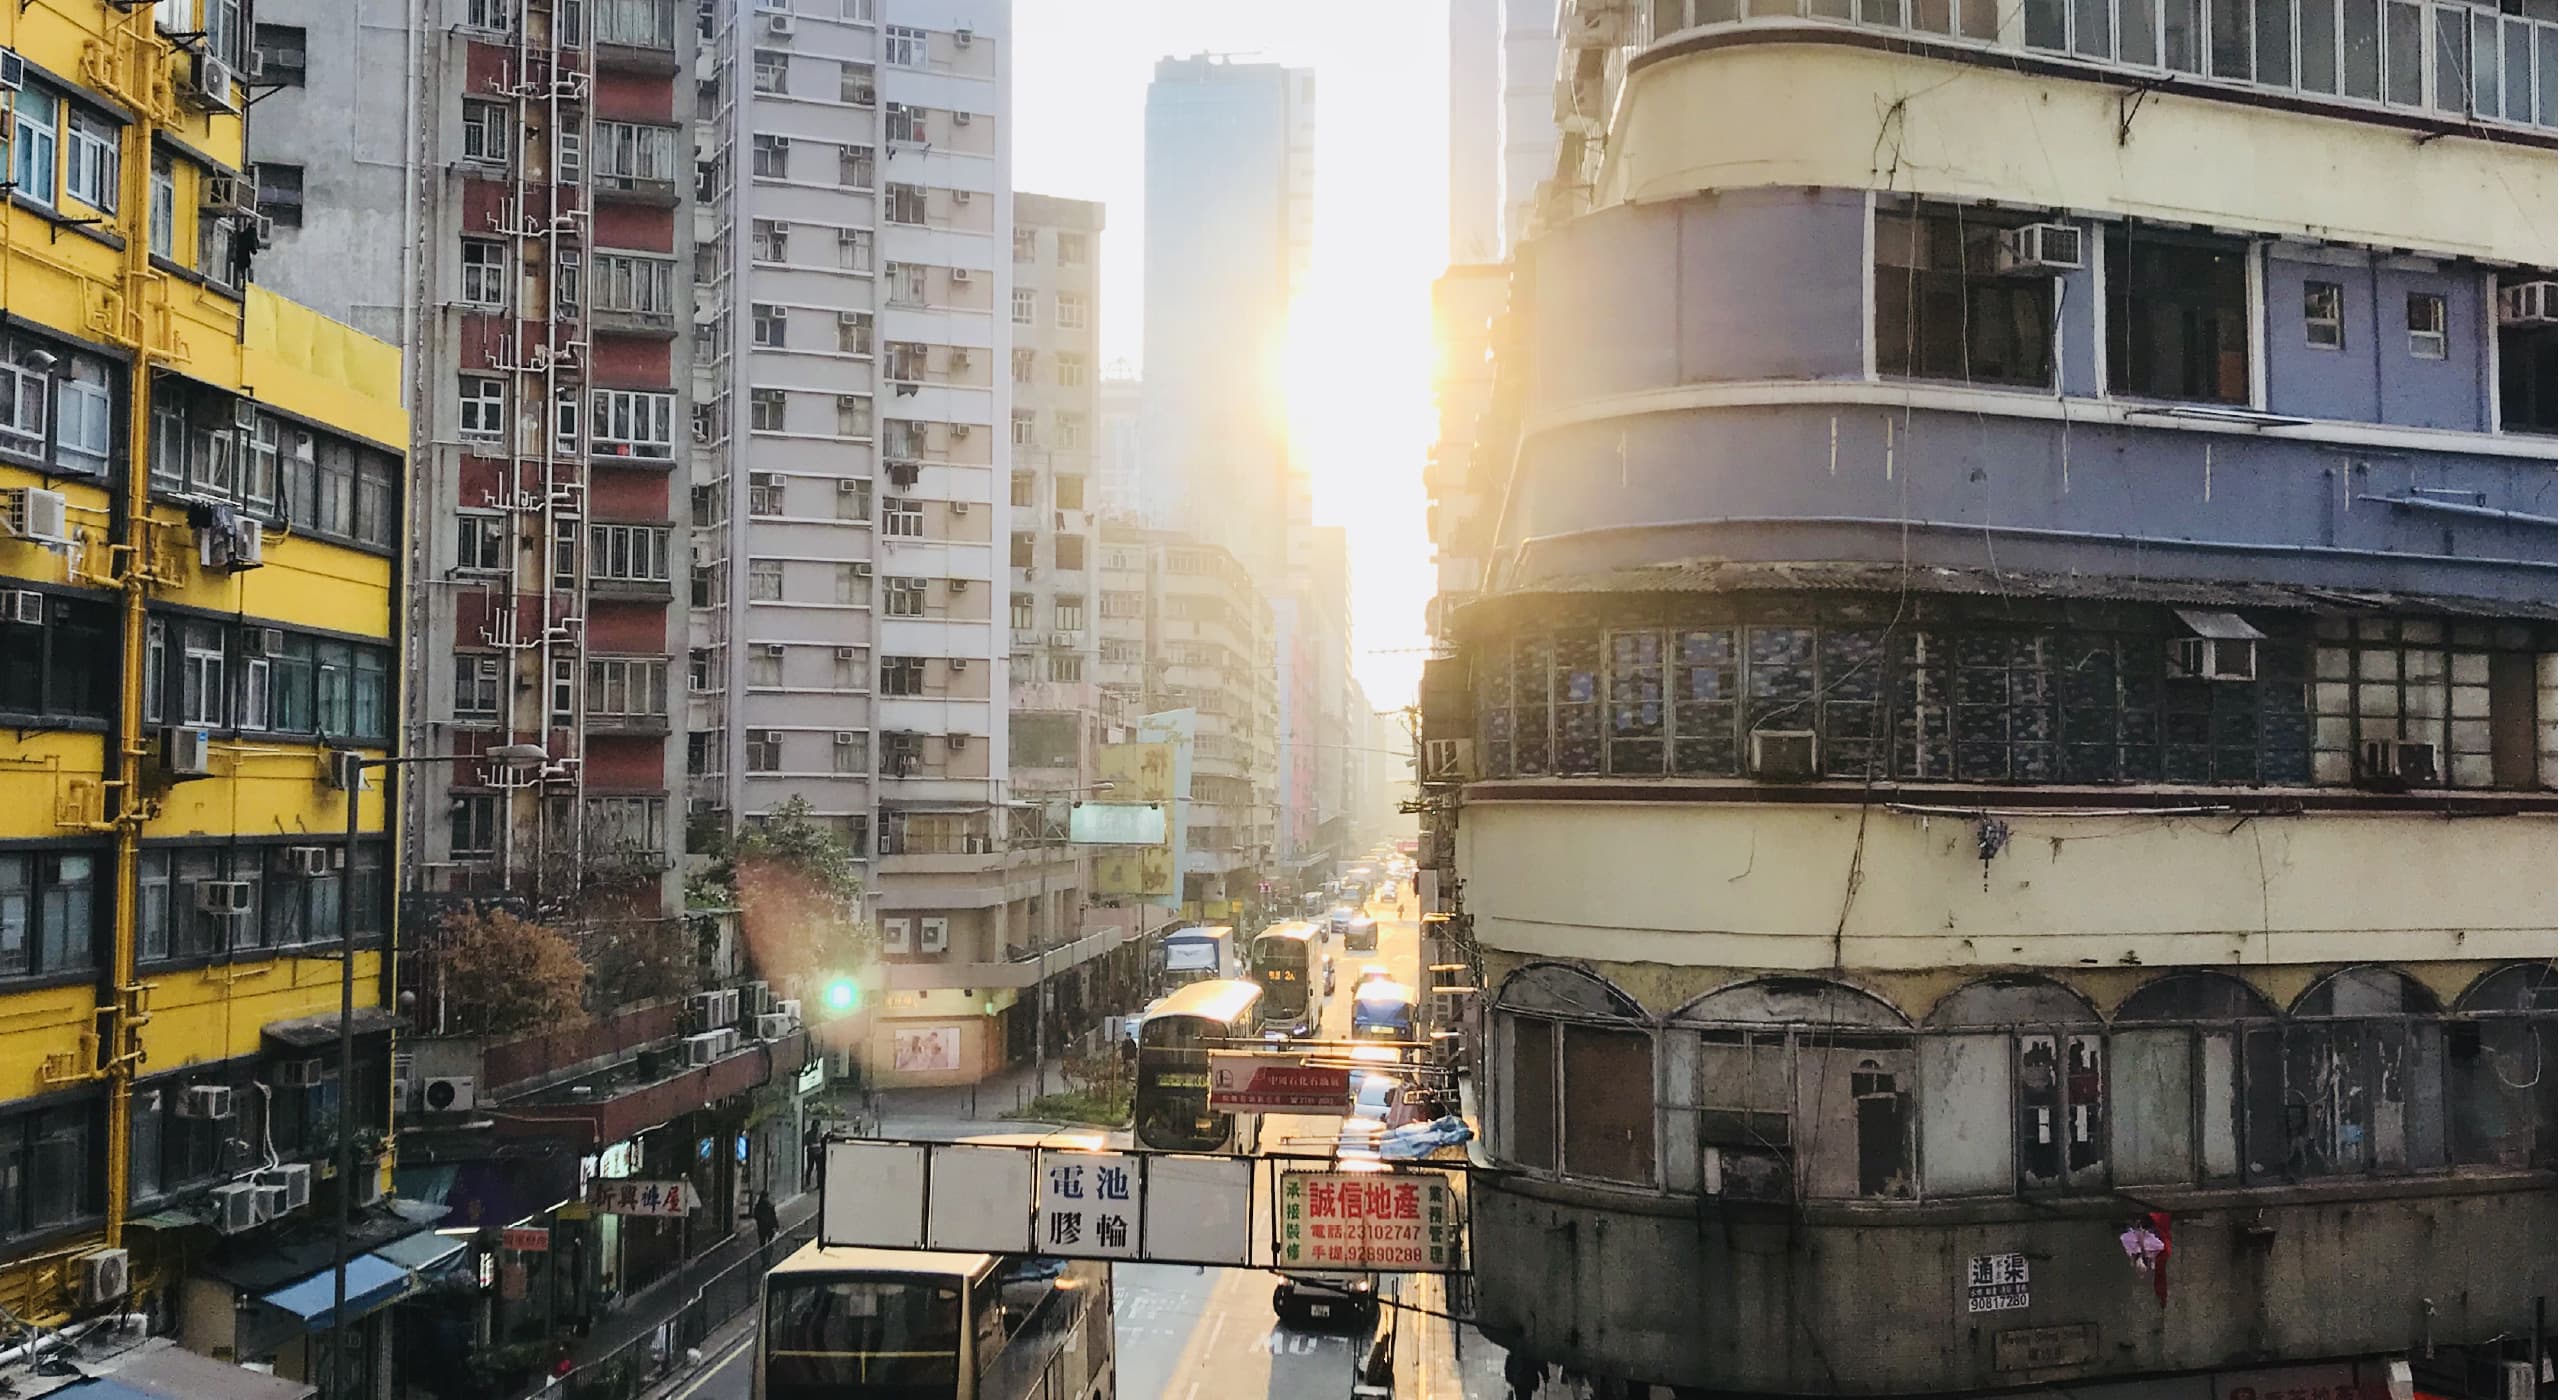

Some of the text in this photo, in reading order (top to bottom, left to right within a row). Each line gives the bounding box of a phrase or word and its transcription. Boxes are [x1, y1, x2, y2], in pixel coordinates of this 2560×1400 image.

[1050, 1165, 1129, 1200] 電池
[1309, 1182, 1420, 1220] 誠信地產
[1050, 1212, 1128, 1248] 膠輪
[1286, 1181, 1300, 1260] 承接裝修
[1972, 1254, 2025, 1284] 通渠
[1970, 1295, 2027, 1311] 90817280
